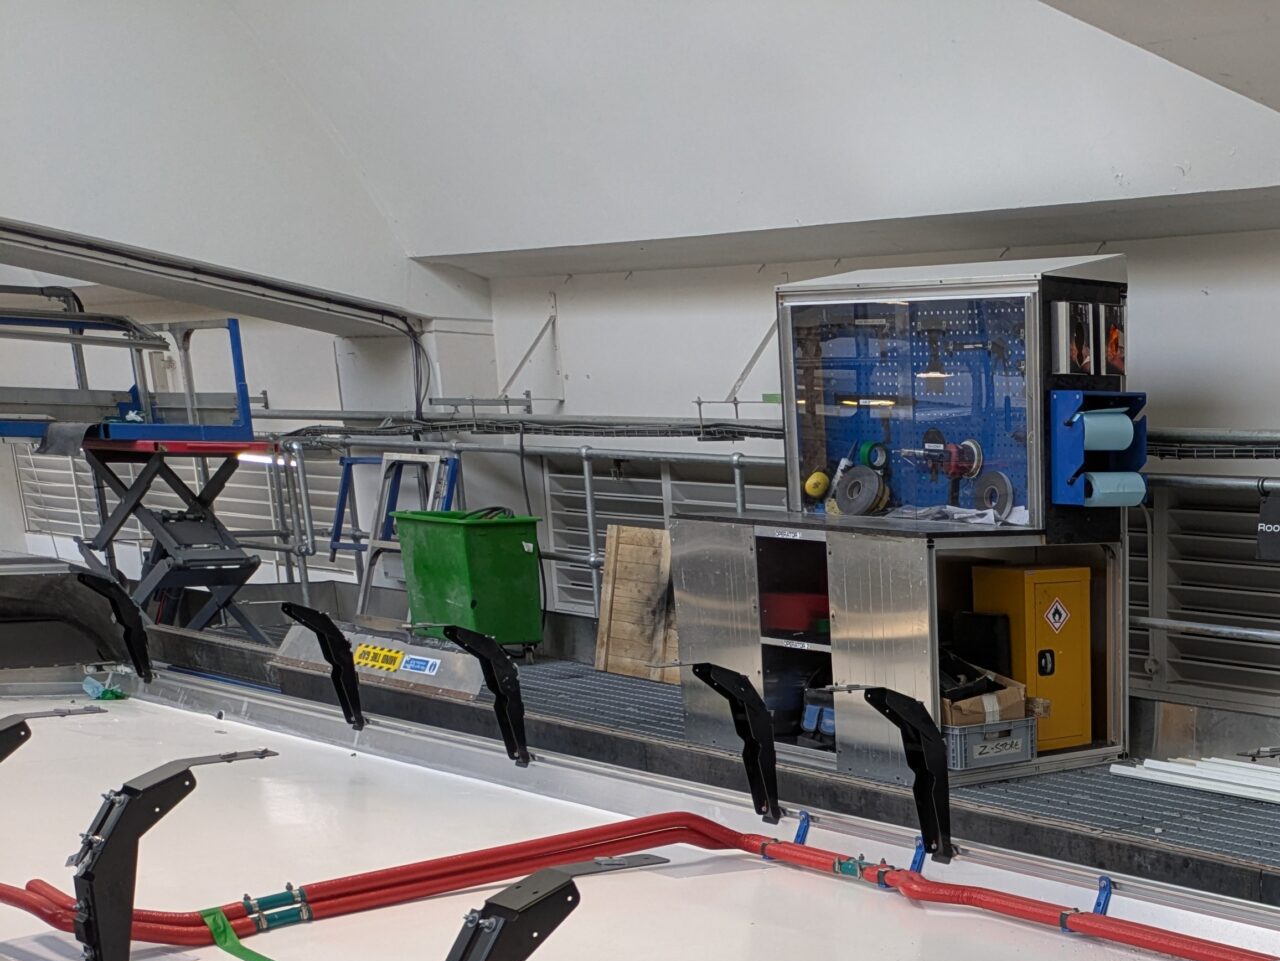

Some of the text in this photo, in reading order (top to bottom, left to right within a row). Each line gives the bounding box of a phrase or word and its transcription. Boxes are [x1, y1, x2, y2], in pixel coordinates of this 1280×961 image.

[359, 649, 371, 660] GAP
[370, 652, 381, 663] THE
[381, 654, 398, 666] MIND
